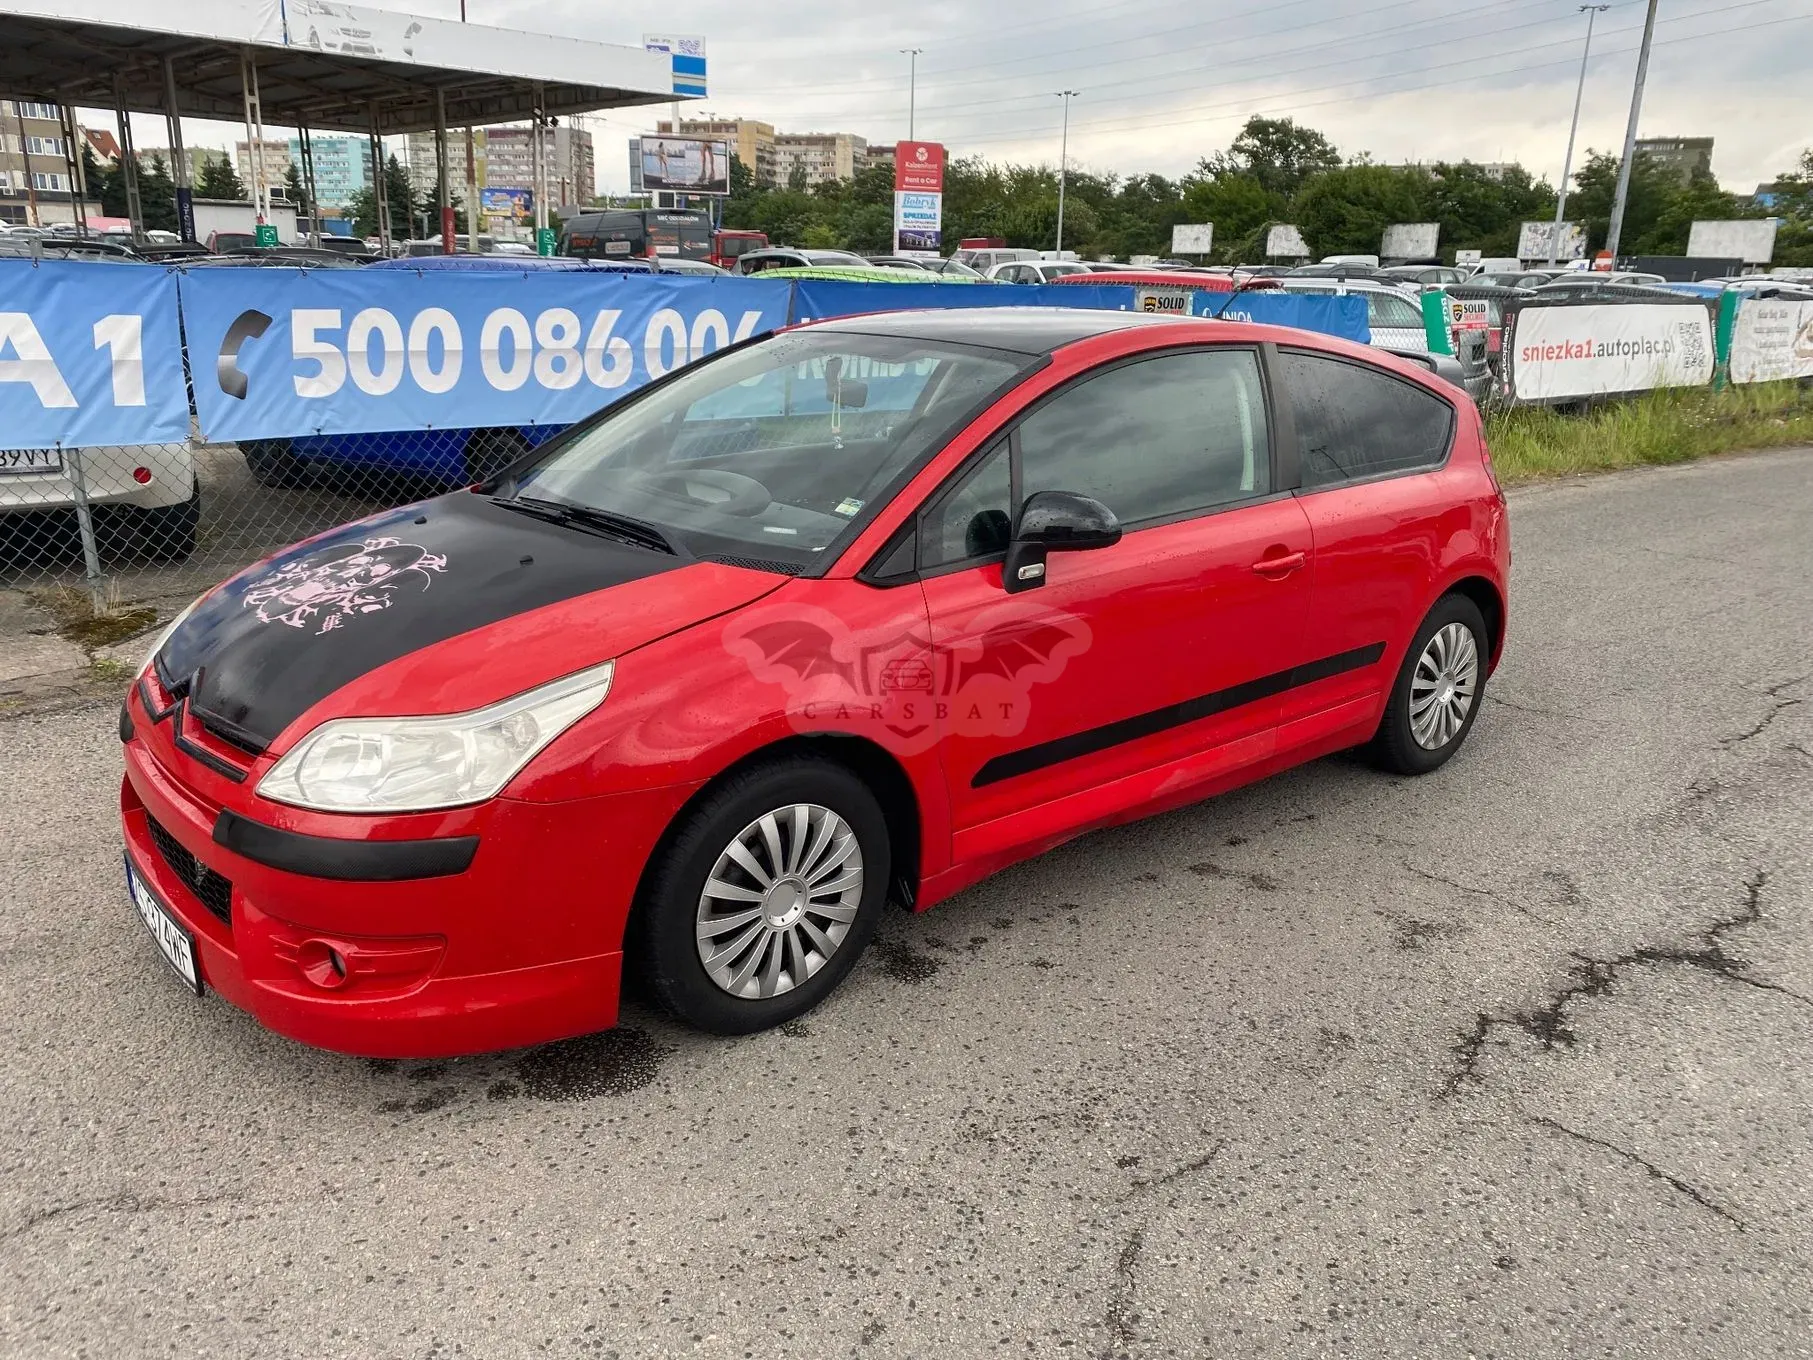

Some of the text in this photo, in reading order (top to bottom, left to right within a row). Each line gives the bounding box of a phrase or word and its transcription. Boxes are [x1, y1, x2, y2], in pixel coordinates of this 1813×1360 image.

[1157, 296, 1185, 310] SOLID
[1463, 303, 1486, 314] SOLID
[93, 314, 146, 407] 1
[292, 307, 463, 398] 500
[480, 307, 633, 391] 086
[1522, 335, 1676, 362] sniezka1.autoplac.pl
